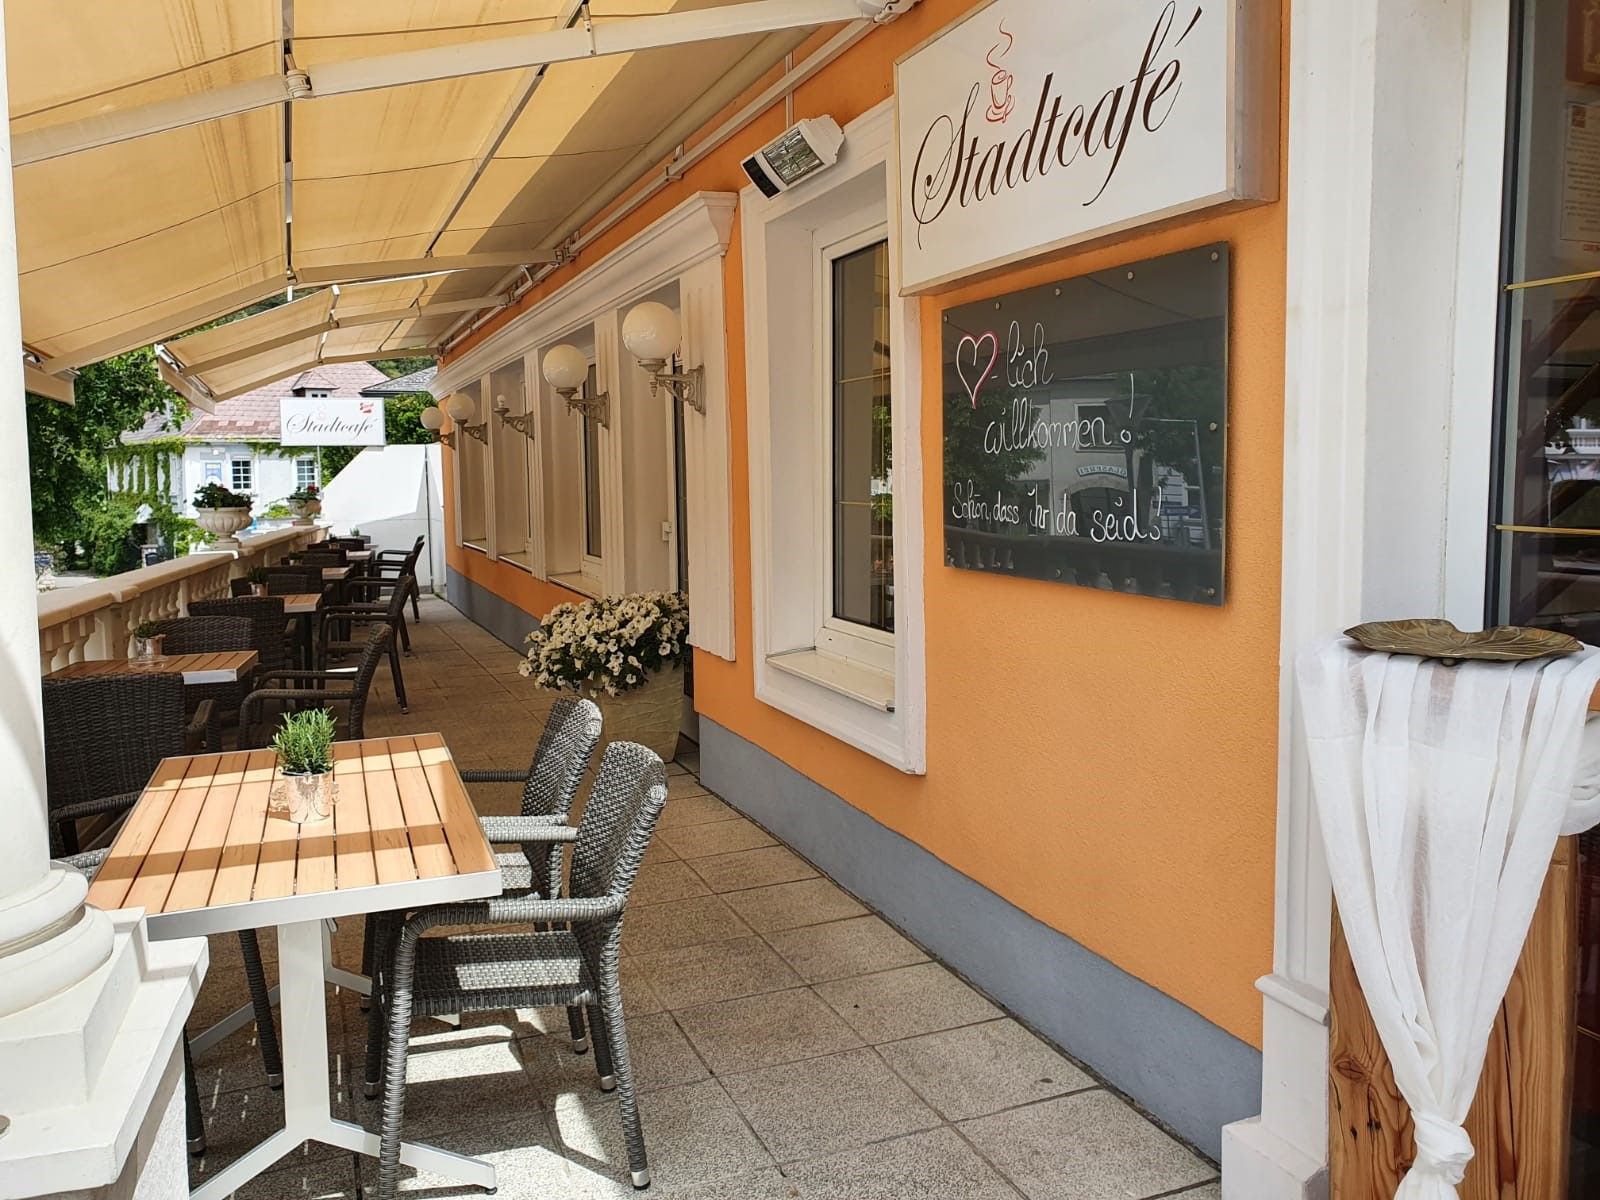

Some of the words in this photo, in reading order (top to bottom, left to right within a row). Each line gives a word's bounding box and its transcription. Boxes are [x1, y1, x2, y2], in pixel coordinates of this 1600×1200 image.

[911, 1, 1203, 250] Stadtcafé
[286, 413, 379, 441] Stadtcafé
[993, 490, 1020, 525] dass
[1056, 493, 1080, 536] da
